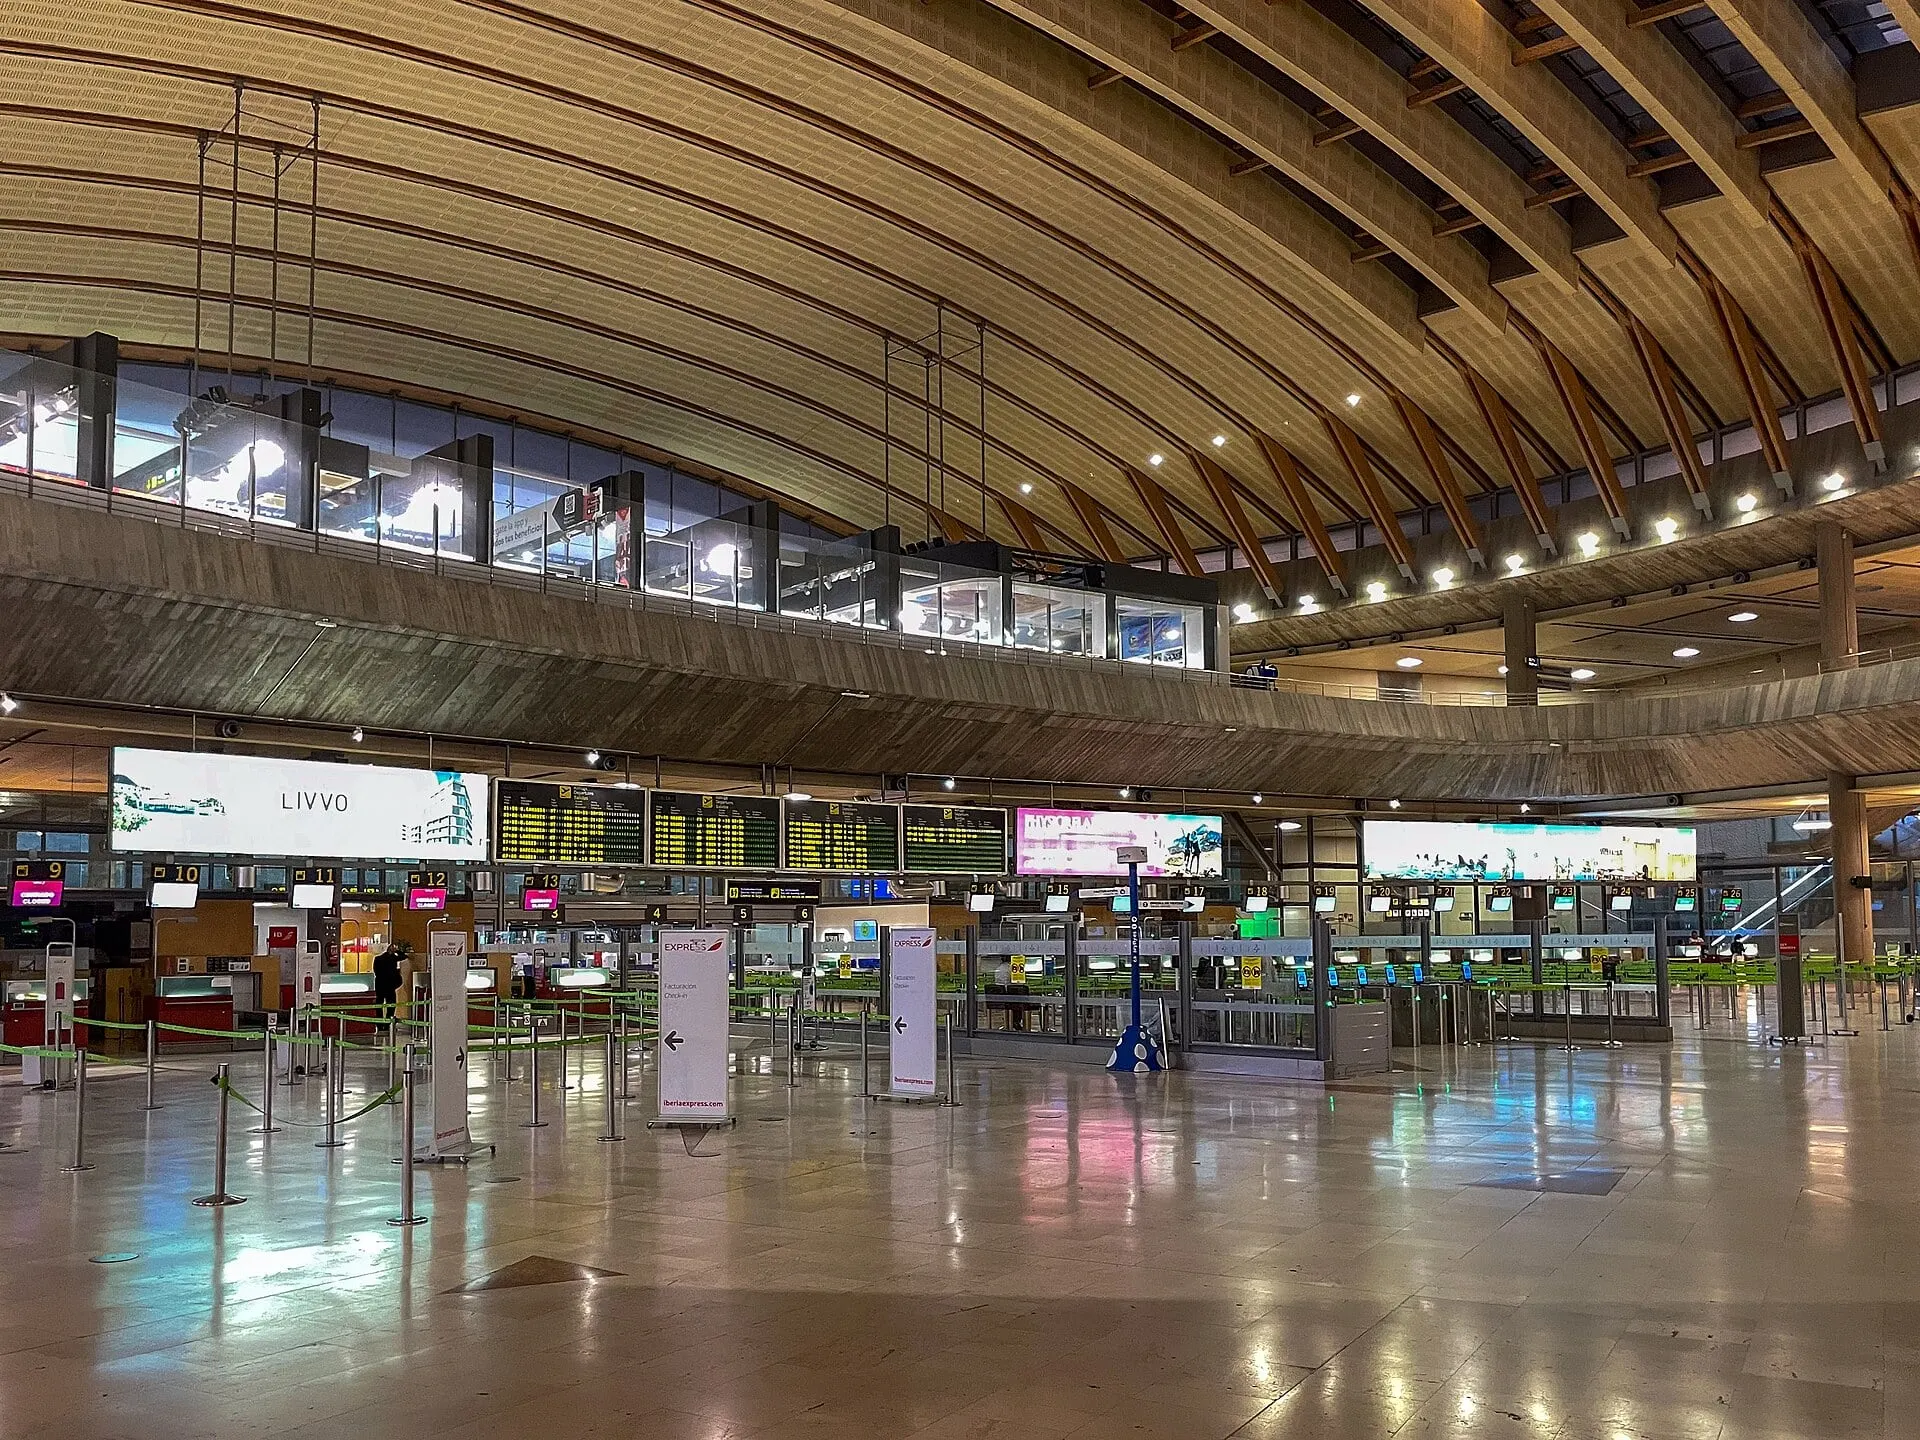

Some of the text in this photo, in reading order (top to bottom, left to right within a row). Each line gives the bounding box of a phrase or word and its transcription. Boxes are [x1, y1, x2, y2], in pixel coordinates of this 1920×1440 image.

[281, 791, 349, 812] LIVVO
[49, 861, 63, 879] 9
[175, 865, 199, 883] 10
[314, 867, 335, 884] 11
[425, 871, 446, 887] 12
[542, 874, 559, 888] 13
[983, 883, 995, 895] 14
[1057, 884, 1069, 895] 15
[1193, 886, 1205, 897] 17
[1256, 886, 1268, 897] 18
[1323, 887, 1335, 897] 19
[1379, 887, 1391, 897] 20
[1444, 887, 1455, 897] 21
[1500, 888, 1511, 897] 22
[1562, 887, 1573, 896] 23
[1620, 887, 1631, 896] 24
[1684, 888, 1696, 897] 25
[1730, 889, 1741, 898] 26
[653, 908, 661, 919] 4
[740, 908, 748, 919] 5
[801, 908, 808, 919] 6
[664, 943, 707, 951] EXPRESS
[894, 939, 922, 948] EXPRESS
